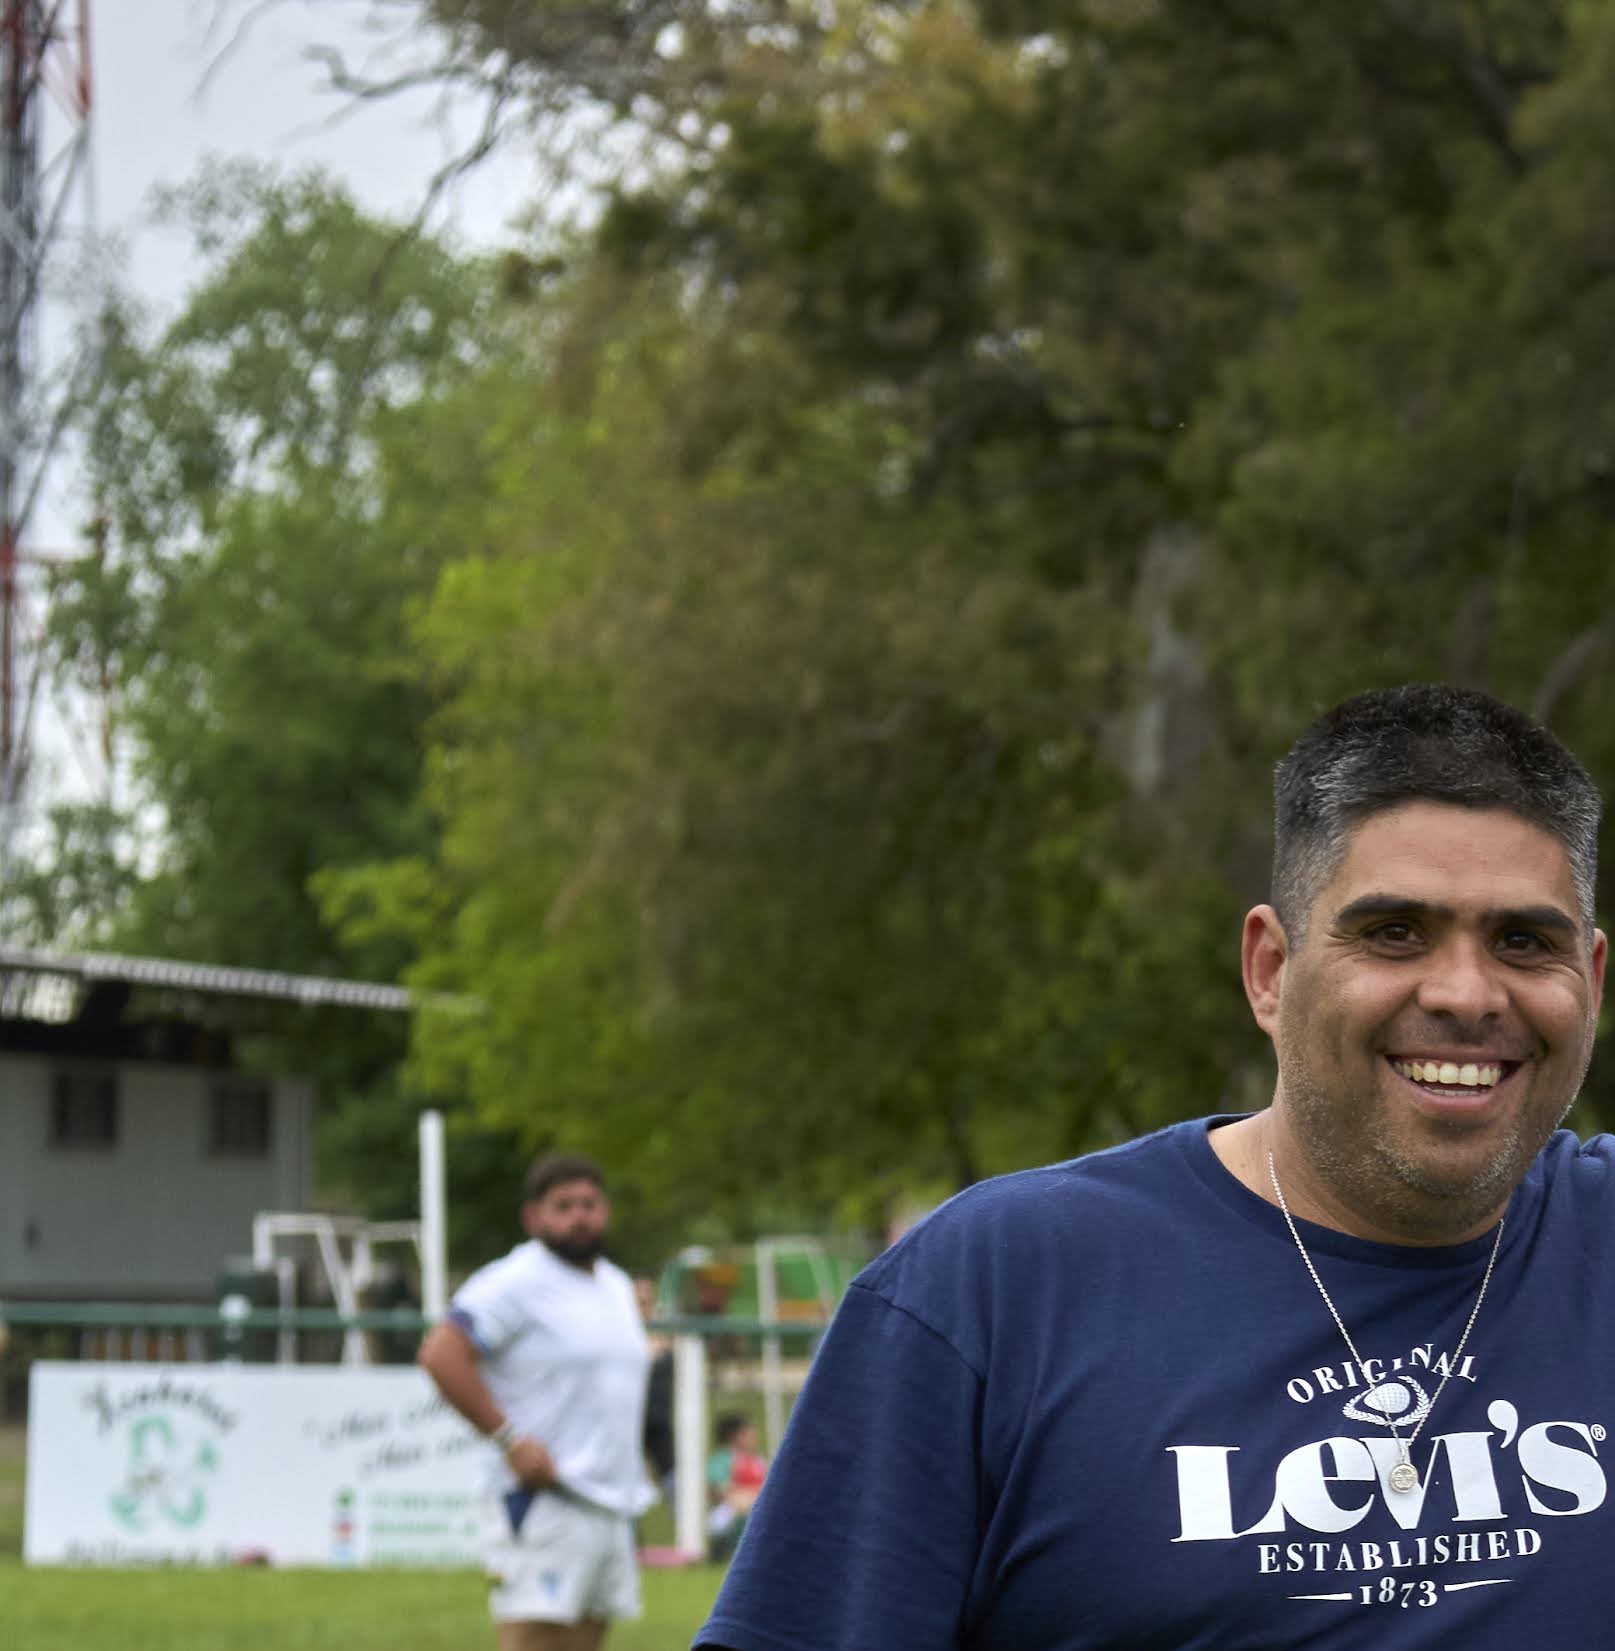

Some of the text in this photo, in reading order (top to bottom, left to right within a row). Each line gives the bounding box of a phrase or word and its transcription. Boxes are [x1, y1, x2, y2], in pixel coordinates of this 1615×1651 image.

[1286, 1343, 1478, 1404] ORIGINAL
[1257, 1527, 1542, 1574] ESTABLISHED
[1359, 1576, 1438, 1609] 1873
